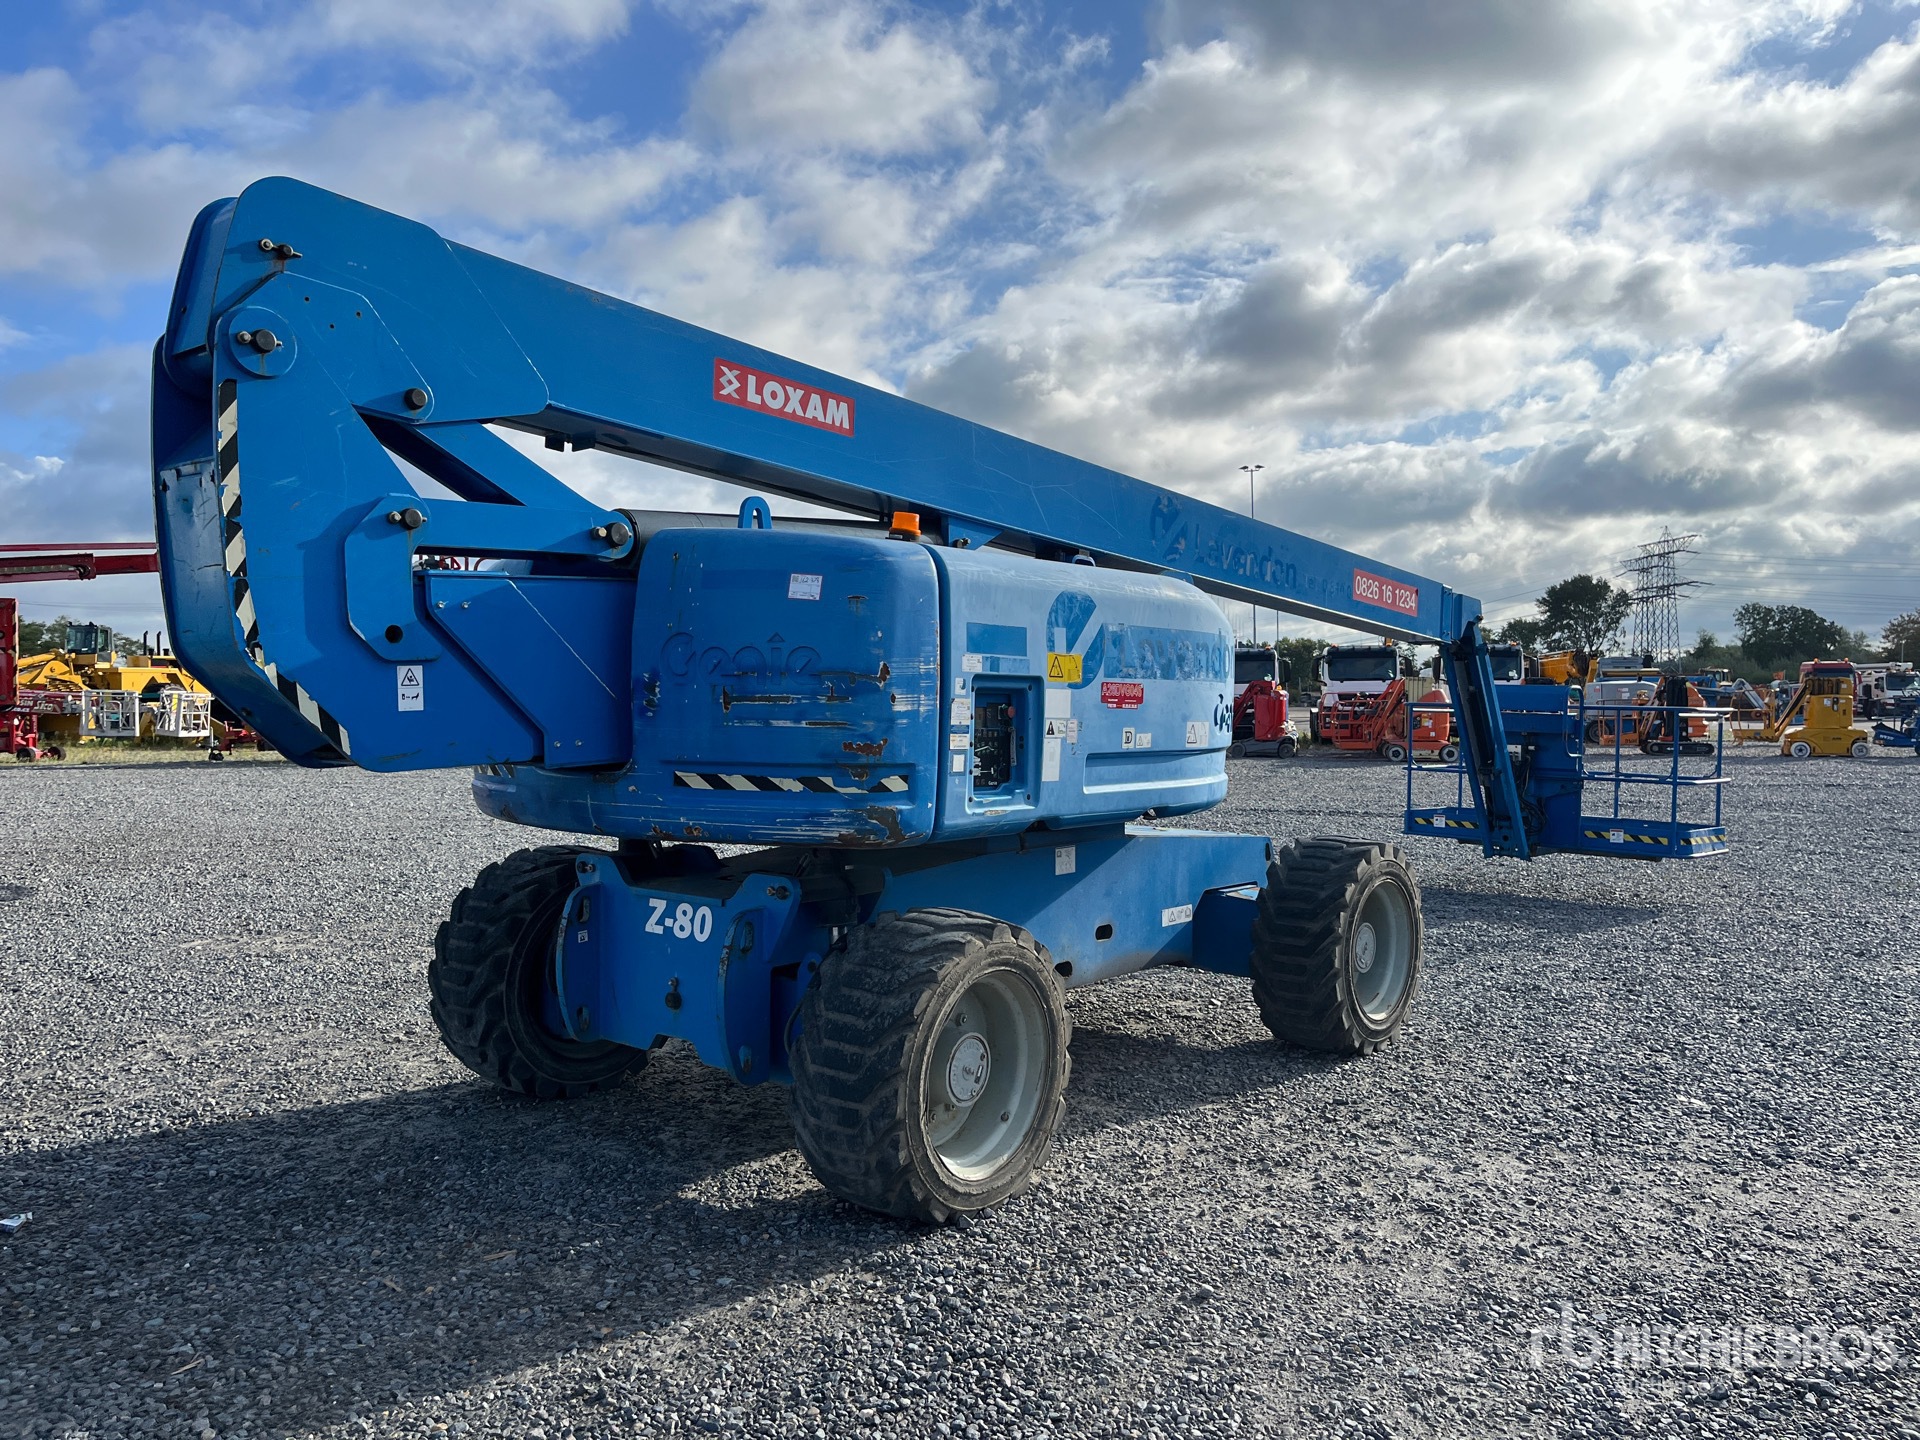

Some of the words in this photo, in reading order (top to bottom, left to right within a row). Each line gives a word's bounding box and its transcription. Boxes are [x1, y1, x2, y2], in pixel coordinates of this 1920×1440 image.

[747, 374, 850, 430] LOXAM
[1355, 576, 1379, 600] 0826
[1382, 584, 1393, 604] 16
[1395, 588, 1416, 611] 1234
[660, 632, 822, 686] Genie
[644, 897, 713, 943] Z-80
